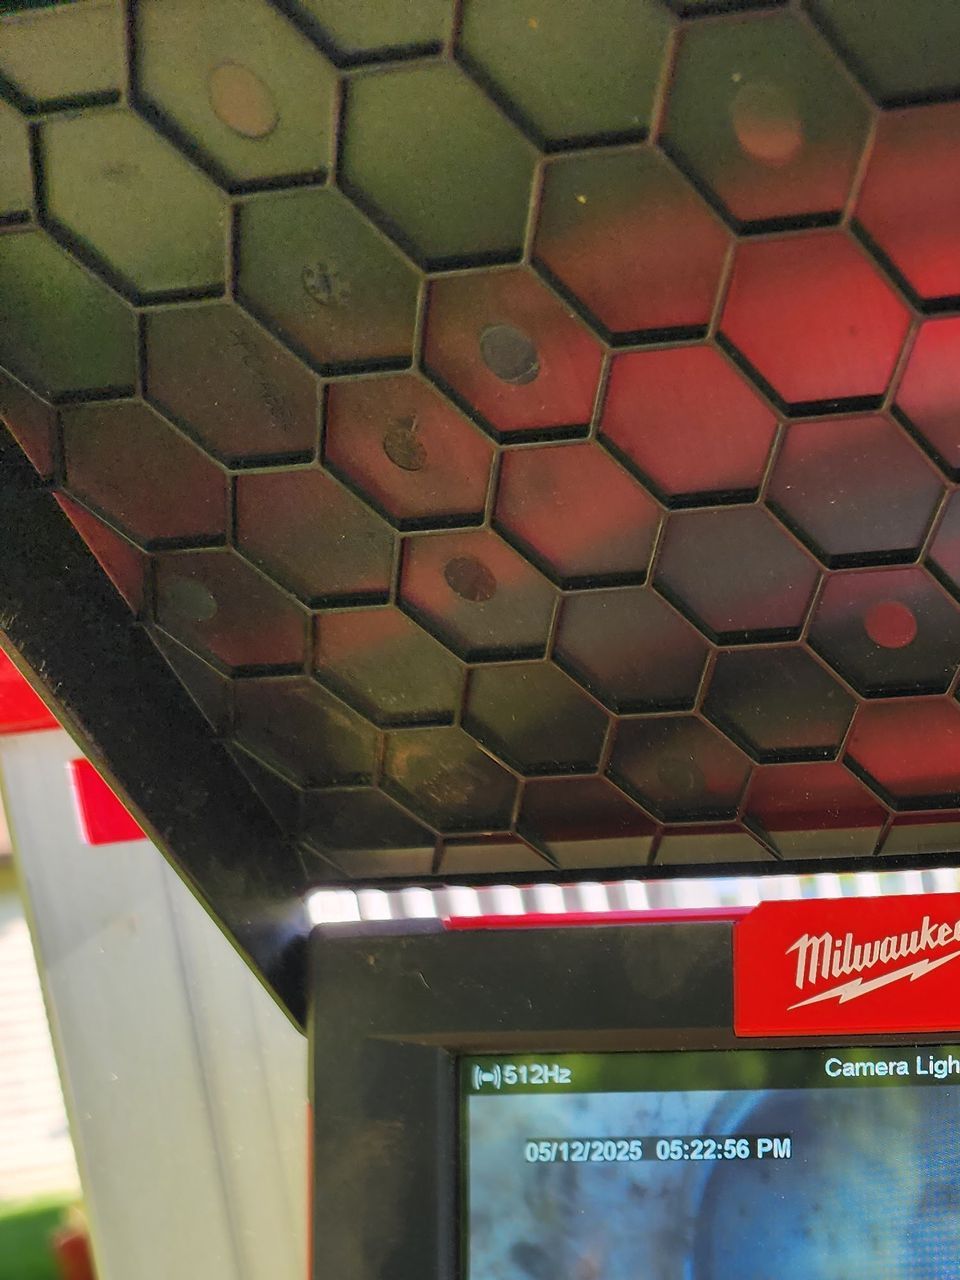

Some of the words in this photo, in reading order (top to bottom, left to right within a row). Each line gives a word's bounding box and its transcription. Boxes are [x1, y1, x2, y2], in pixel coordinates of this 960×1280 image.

[503, 1063, 571, 1085] 512Hz
[825, 1057, 909, 1078] Camera
[525, 1140, 642, 1162] 05/12/2025
[656, 1138, 750, 1160] 05:22:56
[757, 1137, 792, 1159] PM
